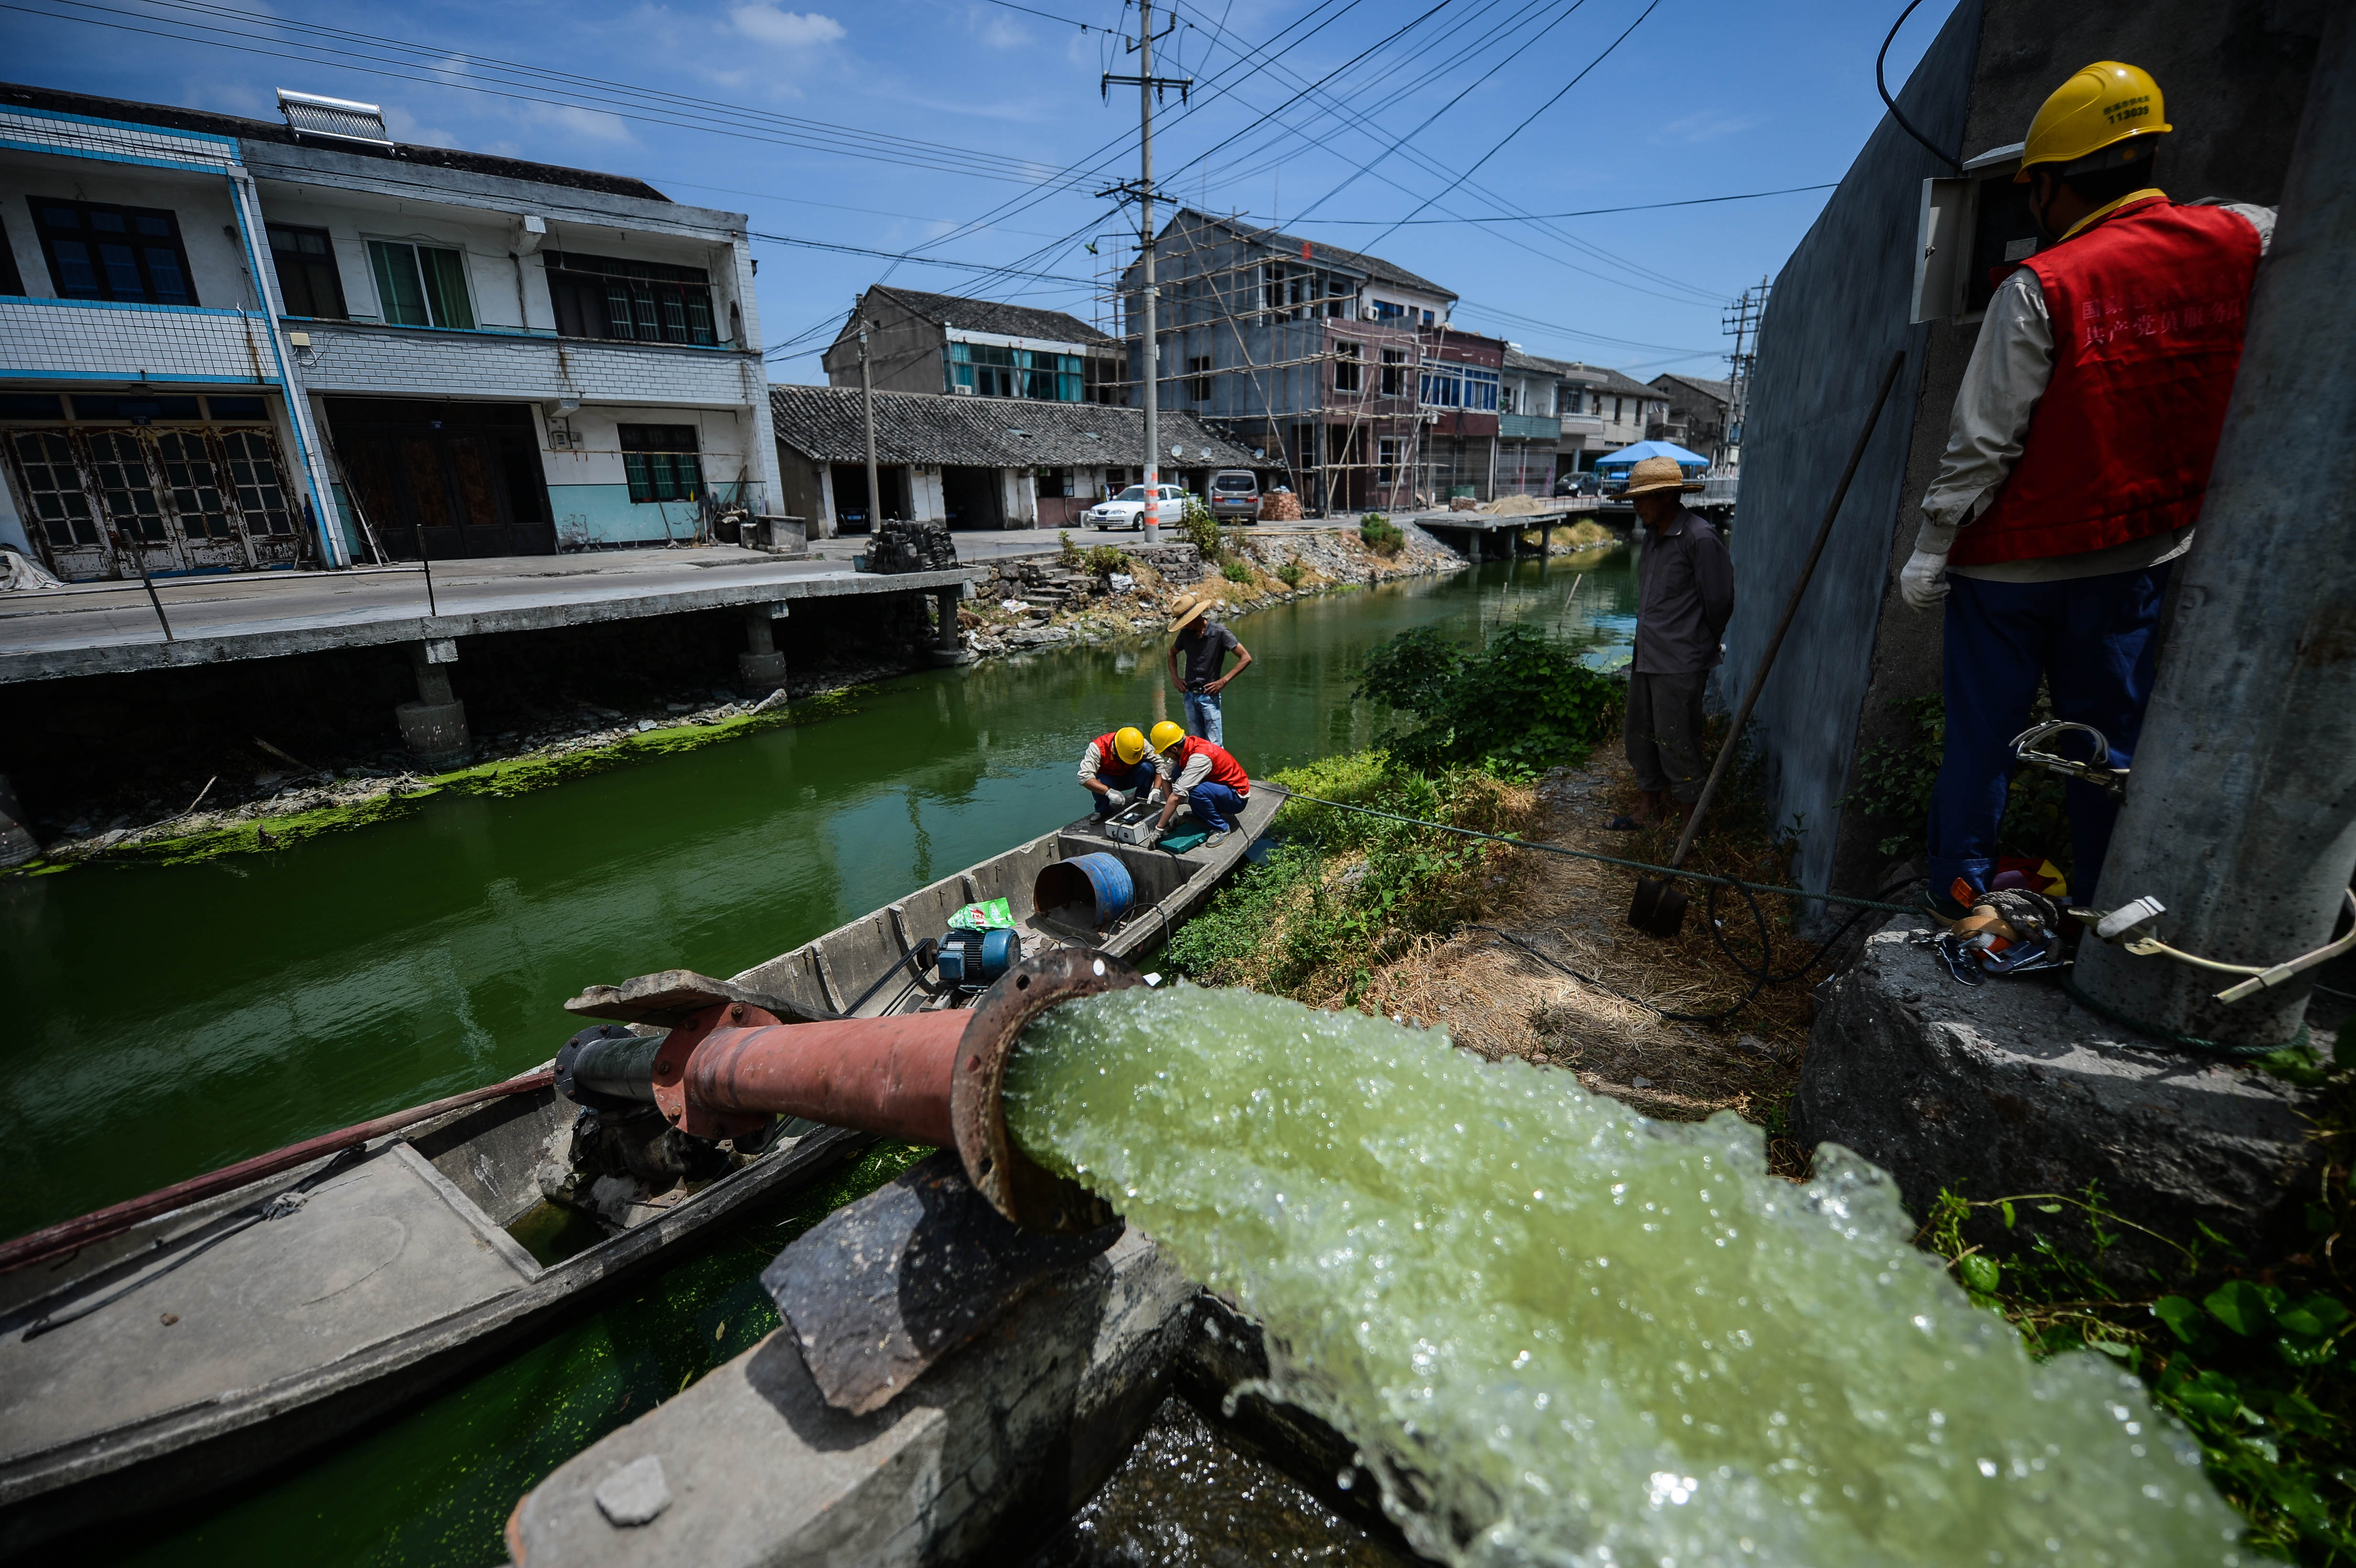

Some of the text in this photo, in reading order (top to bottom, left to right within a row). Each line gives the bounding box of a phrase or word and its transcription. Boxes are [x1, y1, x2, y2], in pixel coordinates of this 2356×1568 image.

[2108, 105, 2149, 124] 113039
[2083, 298, 2241, 348] 共产党员服务队
